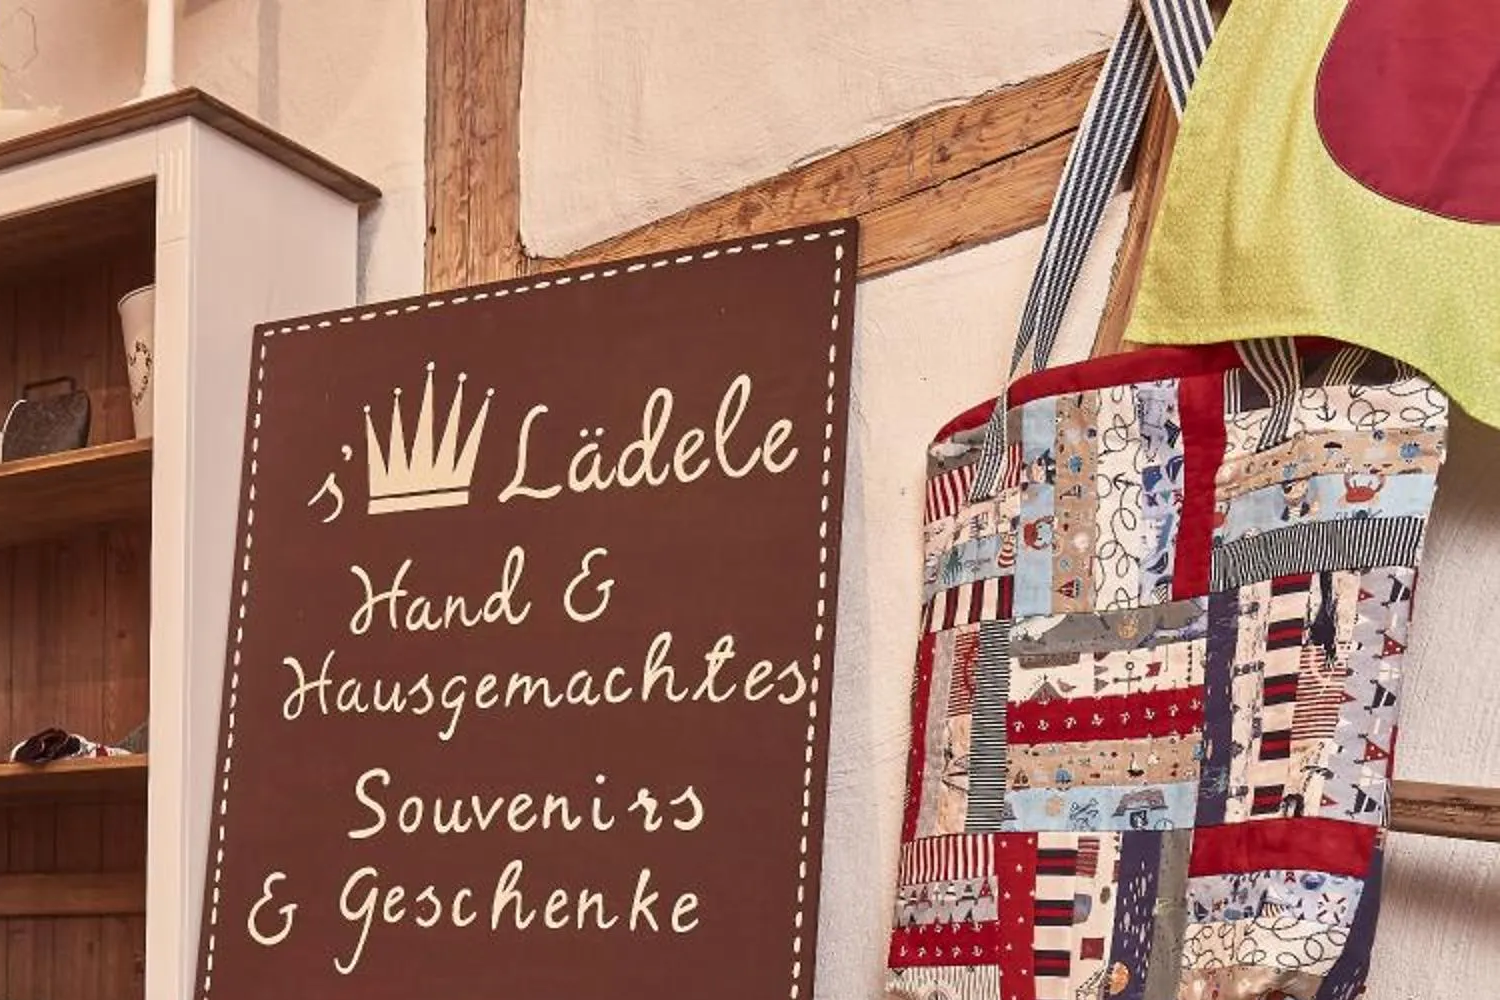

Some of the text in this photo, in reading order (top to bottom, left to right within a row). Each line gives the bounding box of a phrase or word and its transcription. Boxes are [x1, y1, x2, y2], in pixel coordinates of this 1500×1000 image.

[497, 373, 799, 503] Lädele
[349, 545, 615, 635] Hand &
[281, 631, 809, 742] Hausgemachtes
[348, 767, 704, 839] Souvenirs
[247, 859, 699, 975] & Geschenke
